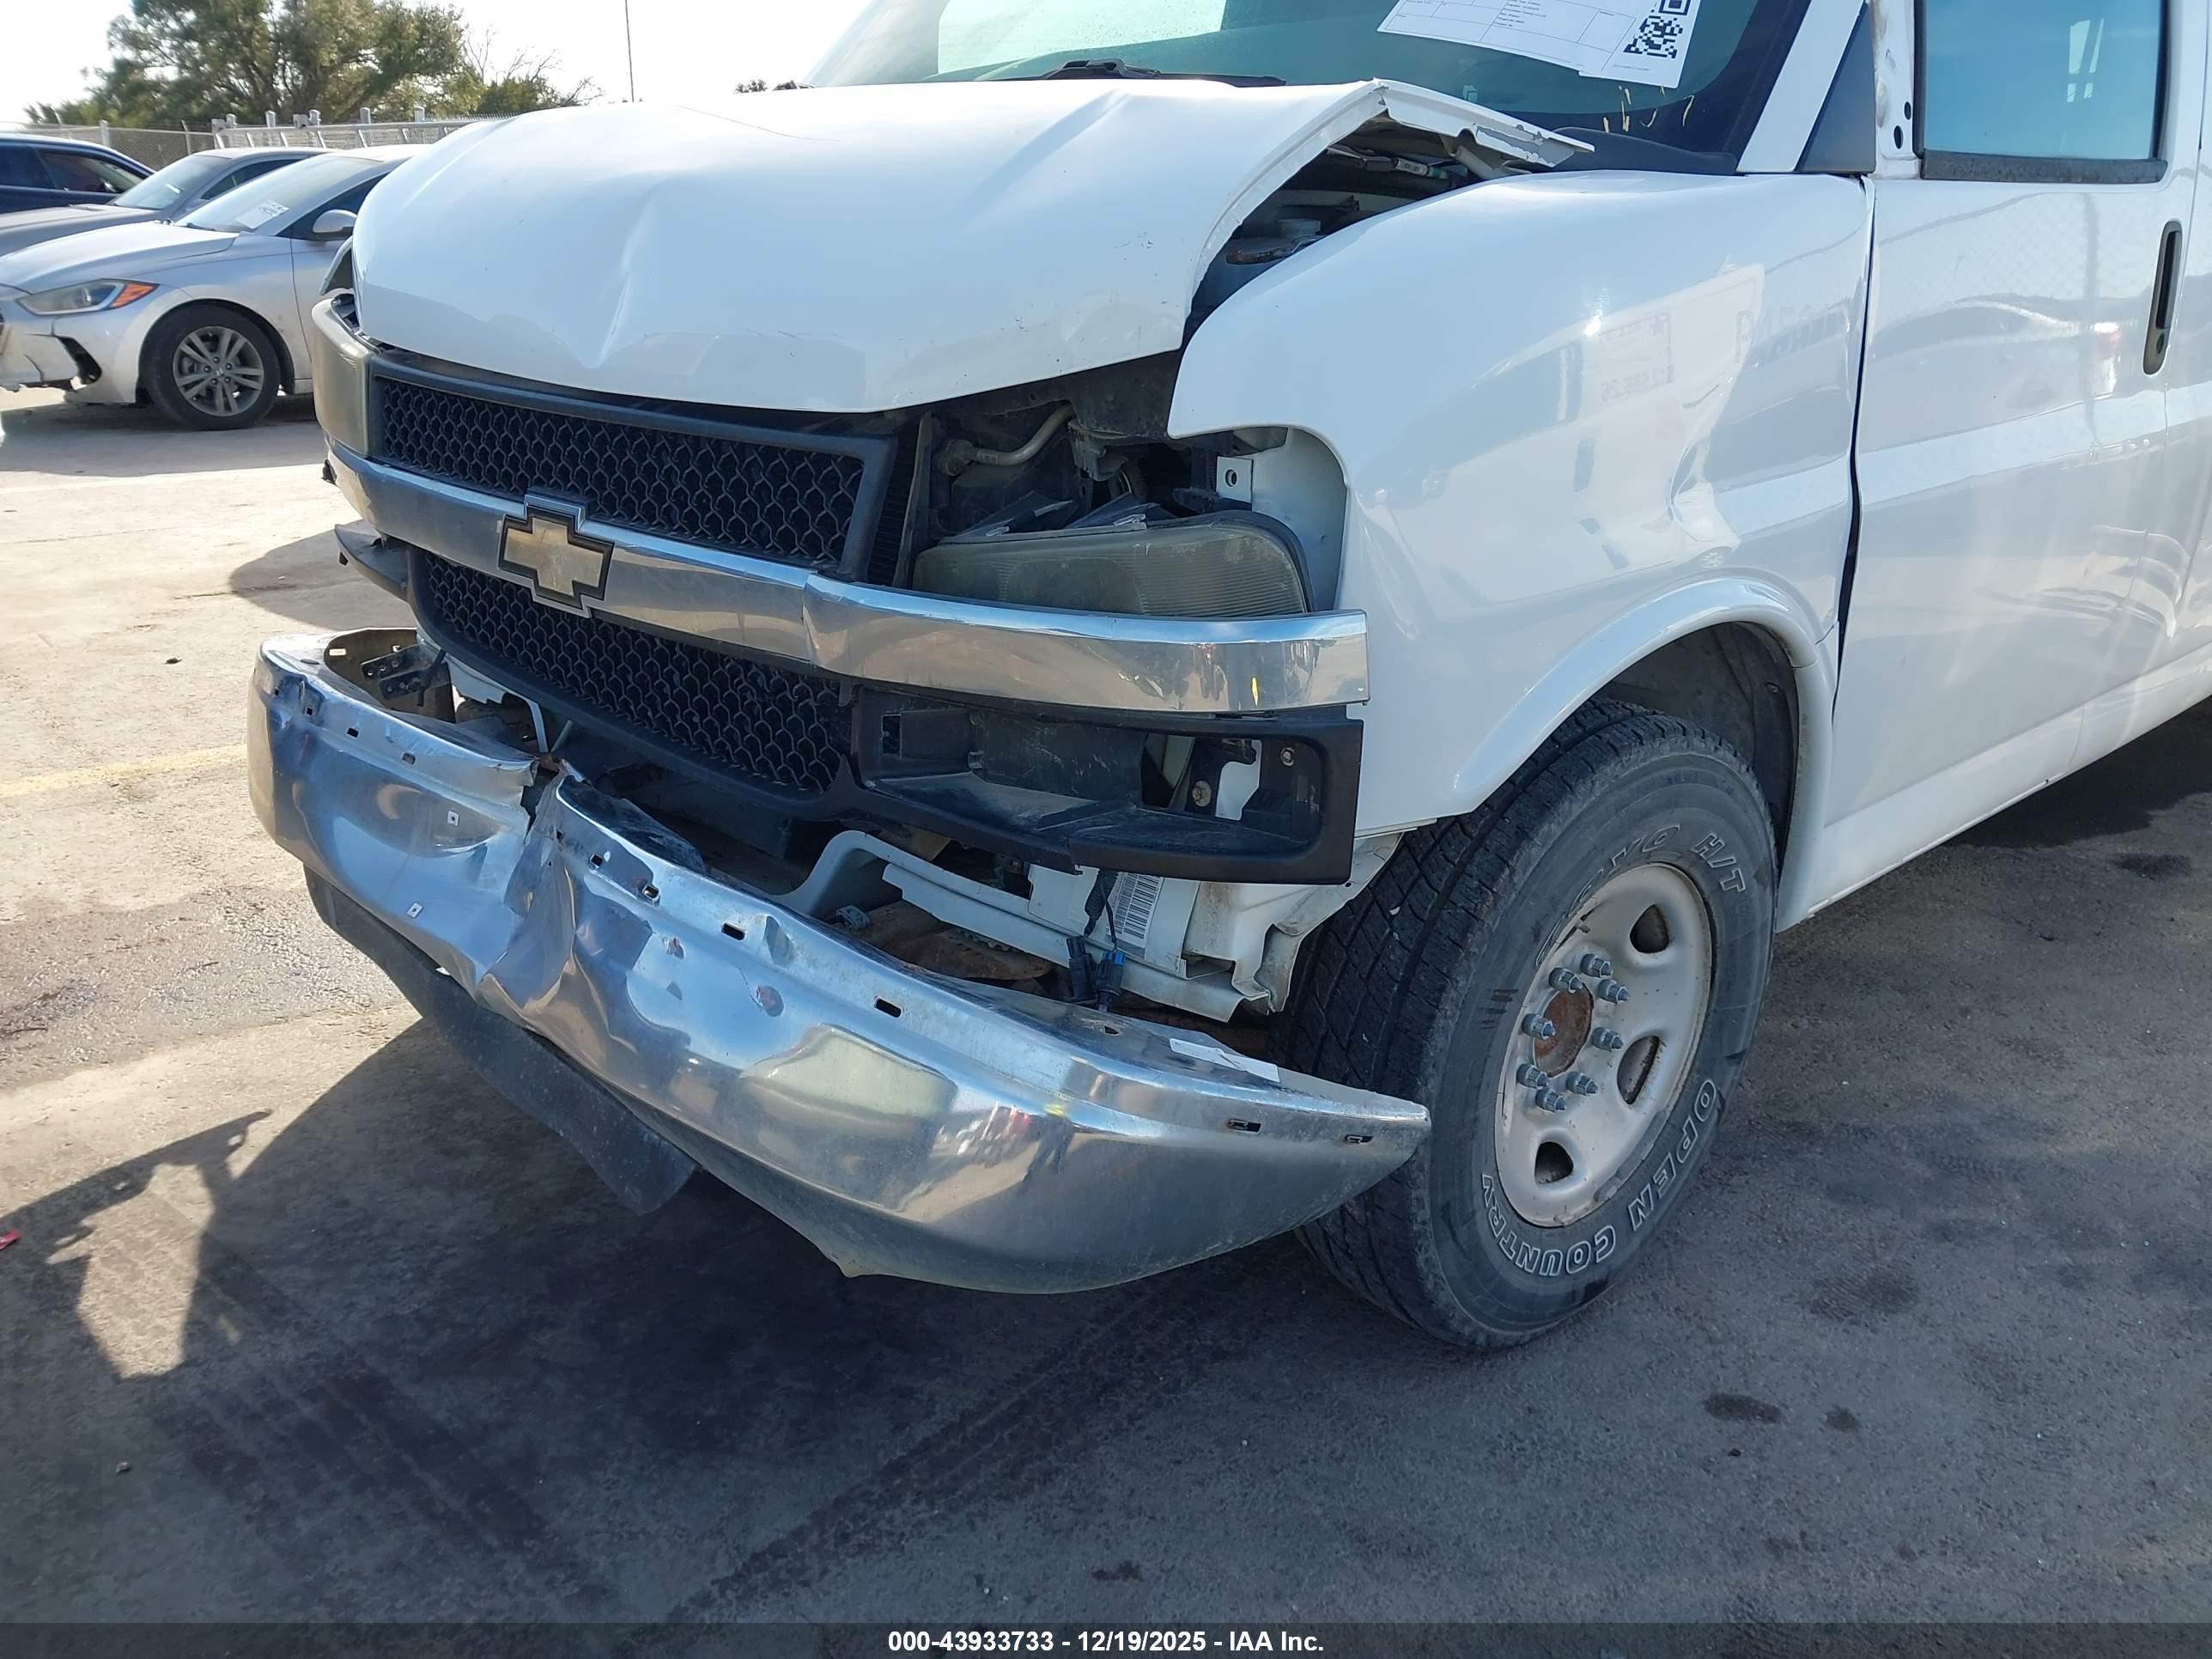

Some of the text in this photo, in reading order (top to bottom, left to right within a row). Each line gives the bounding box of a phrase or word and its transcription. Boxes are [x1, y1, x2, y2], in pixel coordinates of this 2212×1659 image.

[1535, 823, 1680, 968] YO
[1690, 830, 1747, 893] H/T
[1481, 1079, 1717, 1277] OPEN COUNTRY
